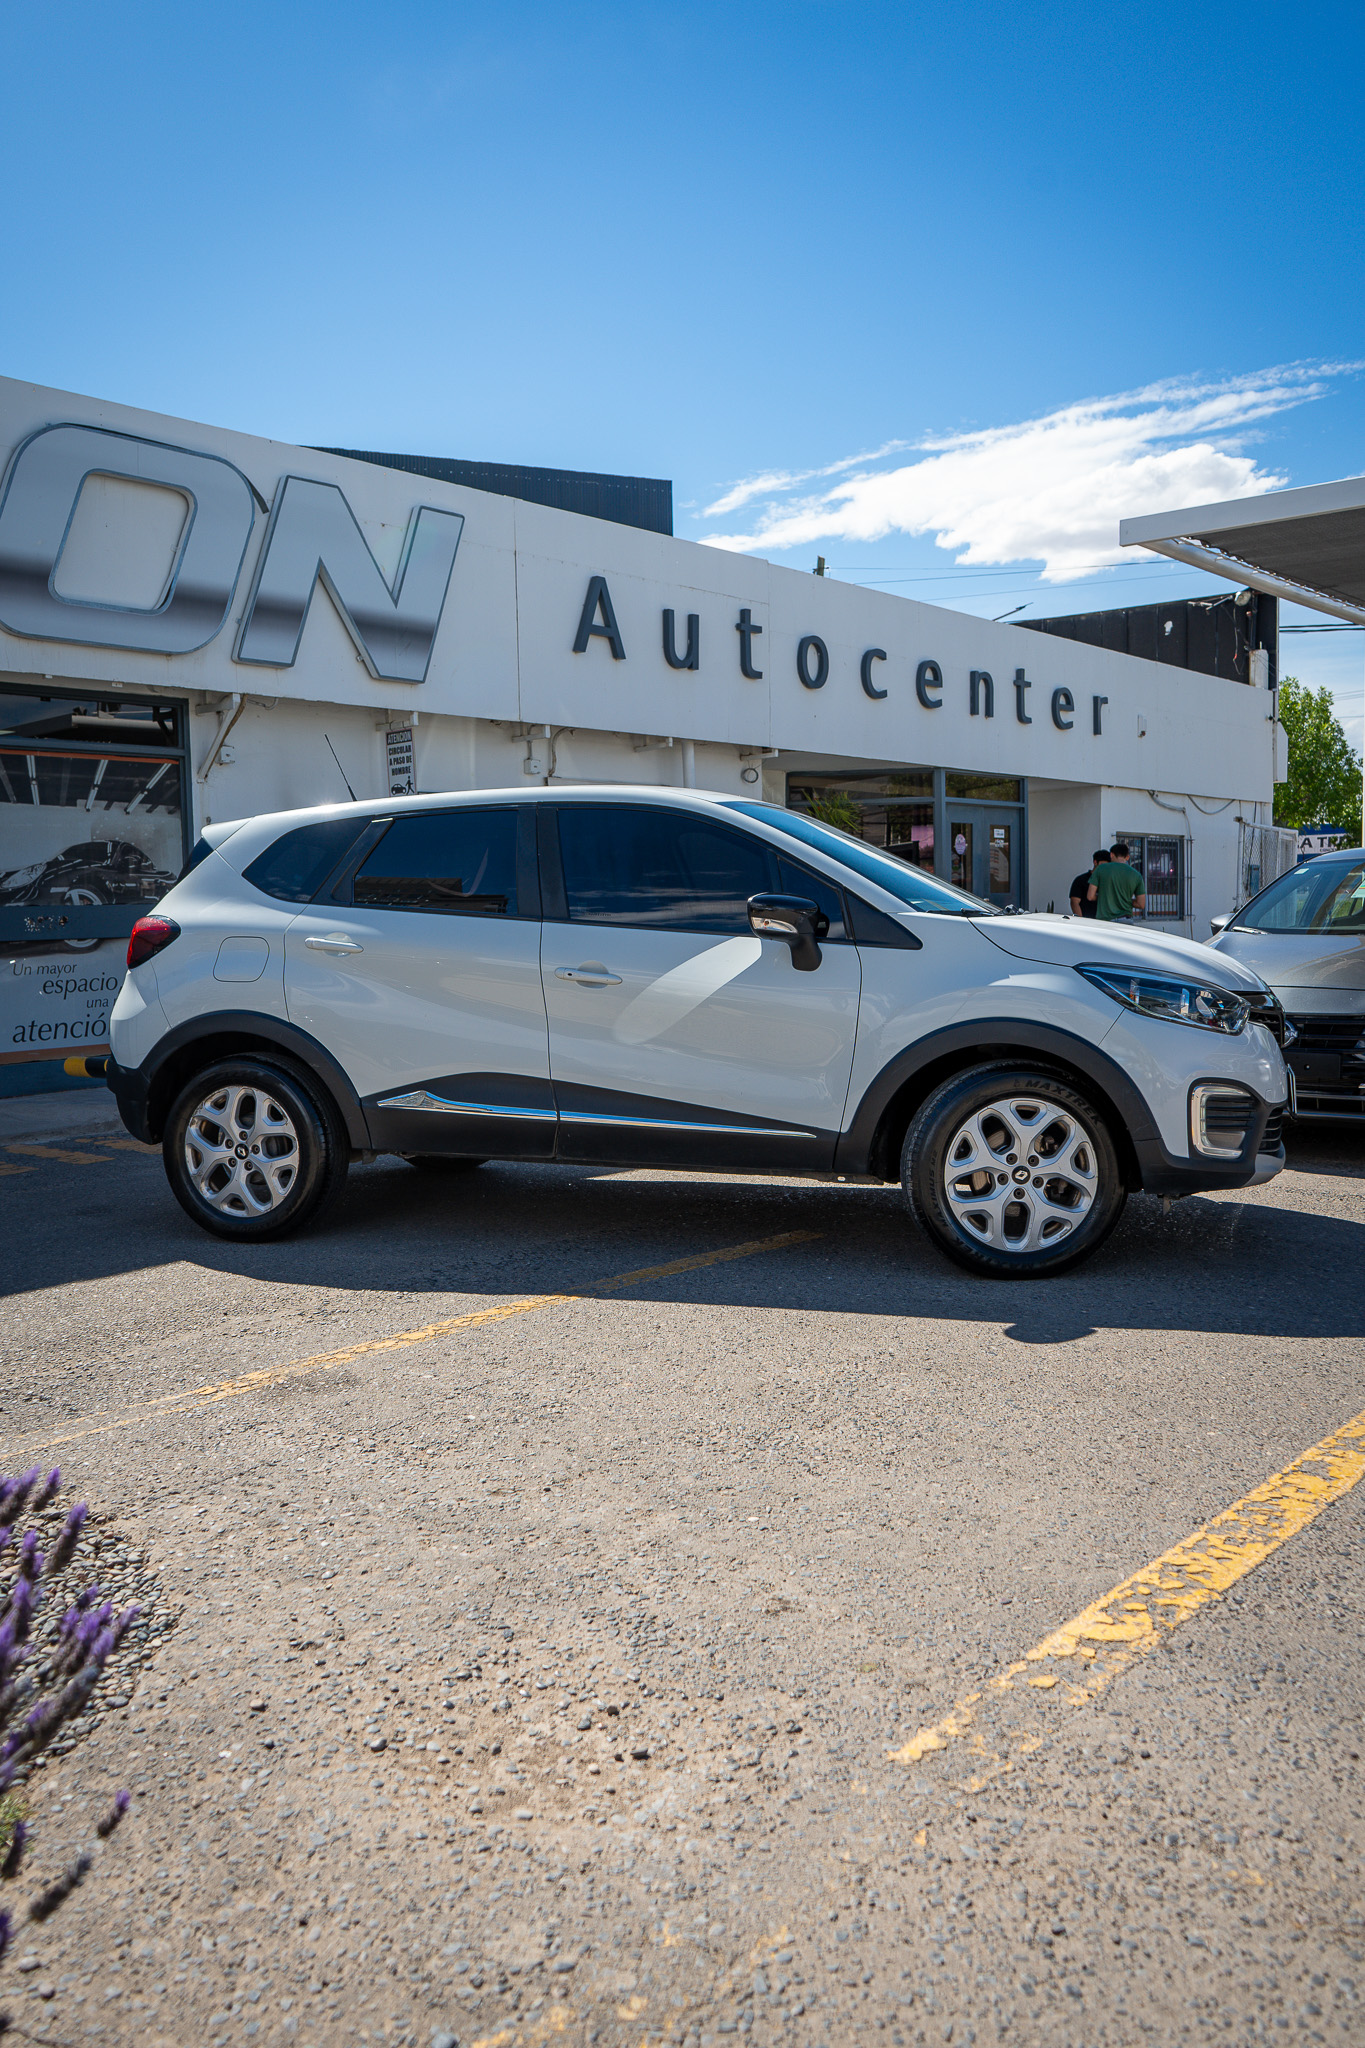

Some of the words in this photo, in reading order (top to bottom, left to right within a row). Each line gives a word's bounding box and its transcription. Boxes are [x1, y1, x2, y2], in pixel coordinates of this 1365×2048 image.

[572, 575, 1108, 736] Autocenter
[389, 745, 411, 756] CIRCULAR
[393, 756, 405, 765] PASO
[406, 755, 412, 763] DE
[392, 766, 411, 776] HOMBRE
[12, 963, 32, 976] Un
[36, 963, 77, 979] mayor
[86, 998, 109, 1008] una
[12, 1013, 110, 1043] atenció
[1025, 1079, 1103, 1125] MAXTREK
